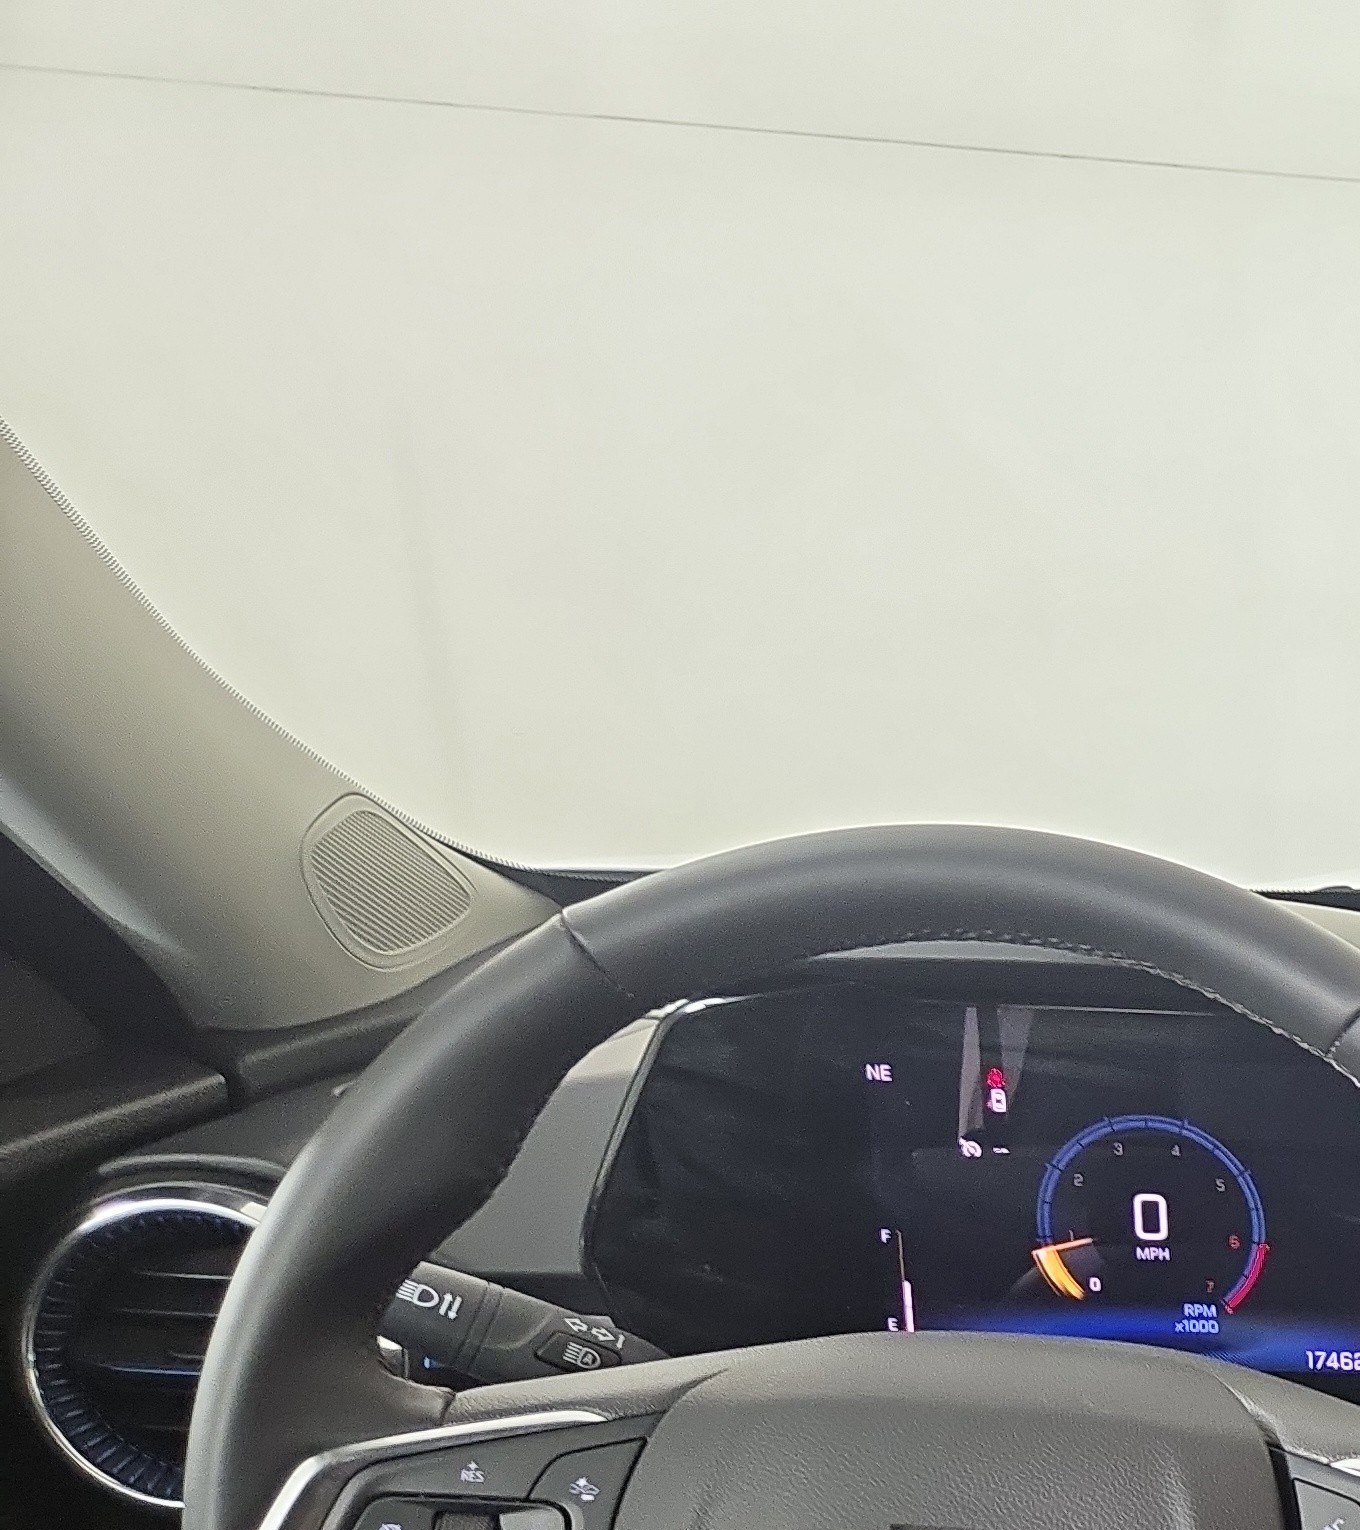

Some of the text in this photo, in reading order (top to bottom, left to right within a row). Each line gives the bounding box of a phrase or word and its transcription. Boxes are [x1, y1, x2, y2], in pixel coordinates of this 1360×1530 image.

[865, 1064, 893, 1082] NE
[1113, 1142, 1124, 1156] 3
[1073, 1173, 1084, 1187] 2
[1133, 1193, 1169, 1241] 0
[880, 1228, 892, 1244] F
[1136, 1247, 1171, 1261] MPH
[1089, 1277, 1102, 1292] 0
[1183, 1303, 1217, 1318] RPM
[887, 1317, 899, 1332] E
[1174, 1319, 1219, 1334] x1000
